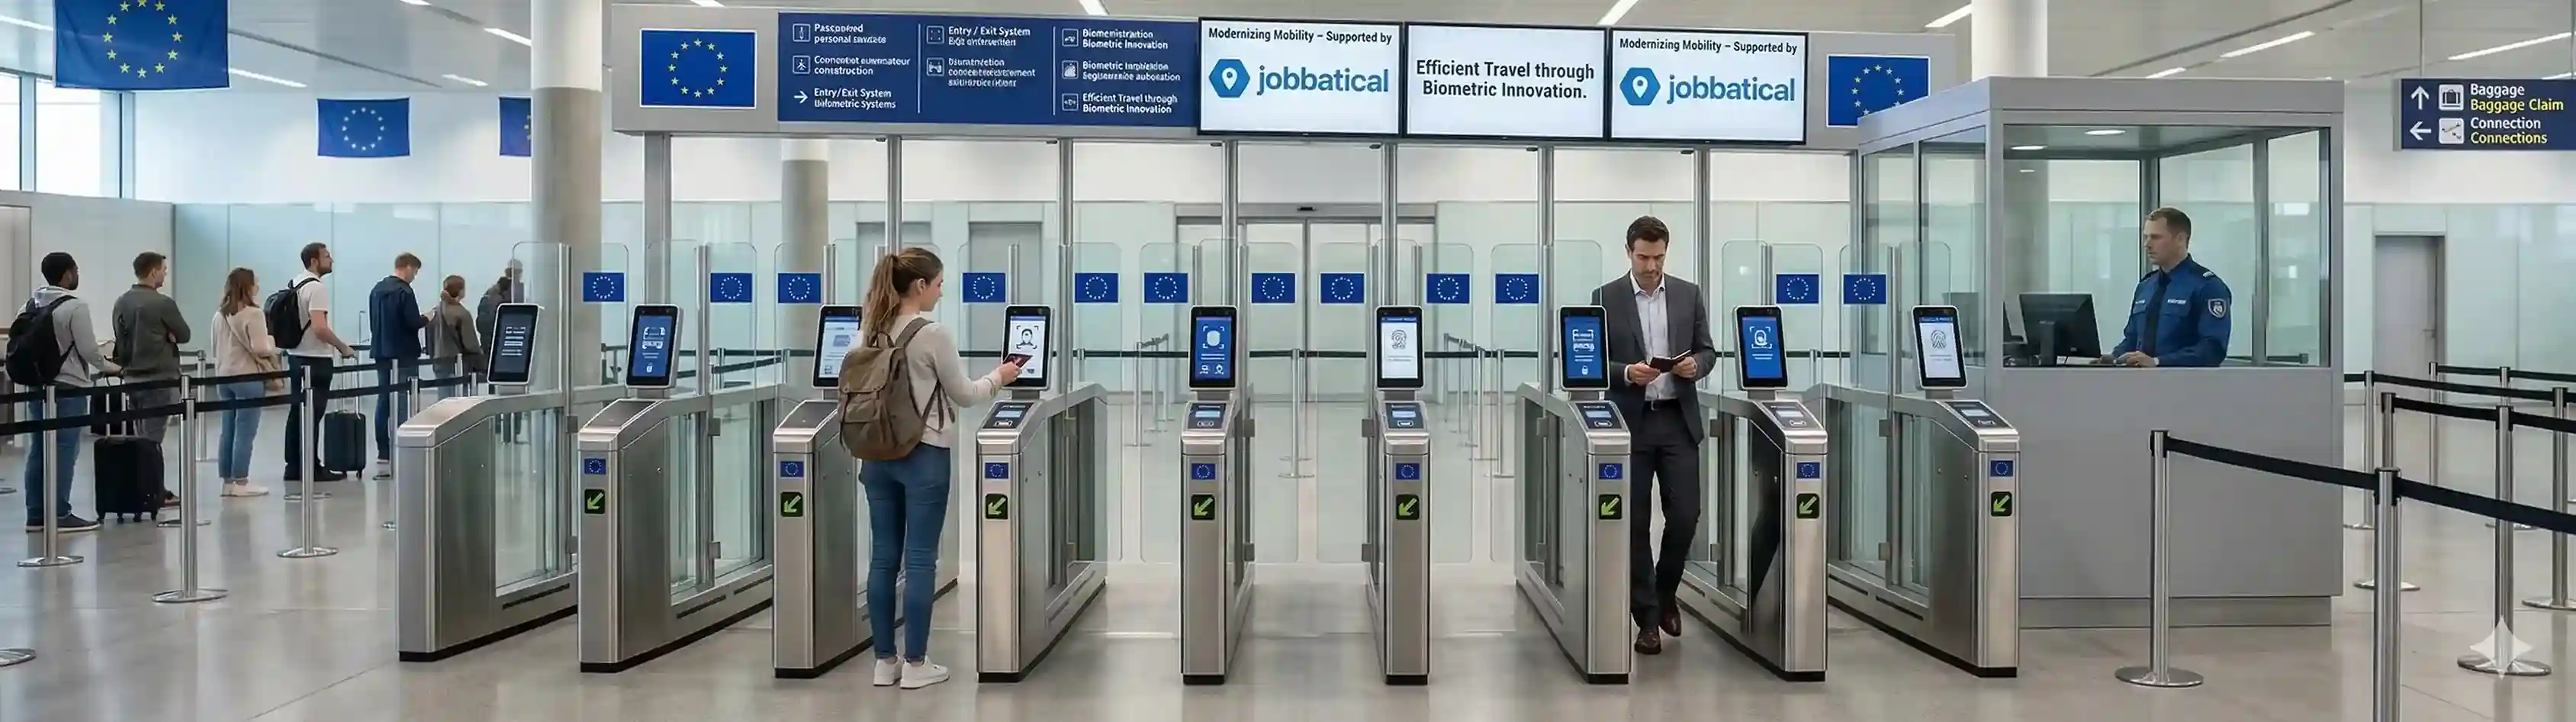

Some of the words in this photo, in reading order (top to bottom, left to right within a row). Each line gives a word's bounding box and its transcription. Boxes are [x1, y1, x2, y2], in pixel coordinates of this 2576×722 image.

[948, 27, 972, 37] Entry
[980, 27, 998, 35] Exit
[999, 27, 1031, 37] System
[1208, 27, 1271, 42] Modernizing
[1274, 29, 1314, 43] Mobility
[1327, 31, 1378, 44] Supported
[1380, 33, 1392, 45] by
[814, 35, 851, 45] personal
[1619, 37, 1680, 52] Modernizing
[1683, 39, 1722, 53] Mobility
[1733, 41, 1783, 54] Supported
[1786, 43, 1797, 55] by
[1082, 61, 1124, 70] Biometric
[1416, 60, 1480, 76] Efficient
[1484, 61, 1531, 77] Travel
[1535, 63, 1594, 82] through
[1256, 65, 1389, 96] jobbatical
[860, 89, 892, 100] System
[1423, 79, 1497, 96] Biometric
[1501, 82, 1587, 98] Innovation.
[1667, 74, 1795, 105] jobbatical
[2470, 83, 2526, 98] Baggage
[1082, 92, 1117, 102] Efficient
[1118, 94, 1143, 103] Travel
[1145, 94, 1178, 105] through
[1082, 104, 1125, 114] Biometric
[1127, 105, 1172, 114] Innovation
[2470, 98, 2525, 114] Baggage
[2529, 98, 2564, 111] Claim
[2470, 117, 2541, 129] Connection
[2470, 132, 2548, 144] Connections
